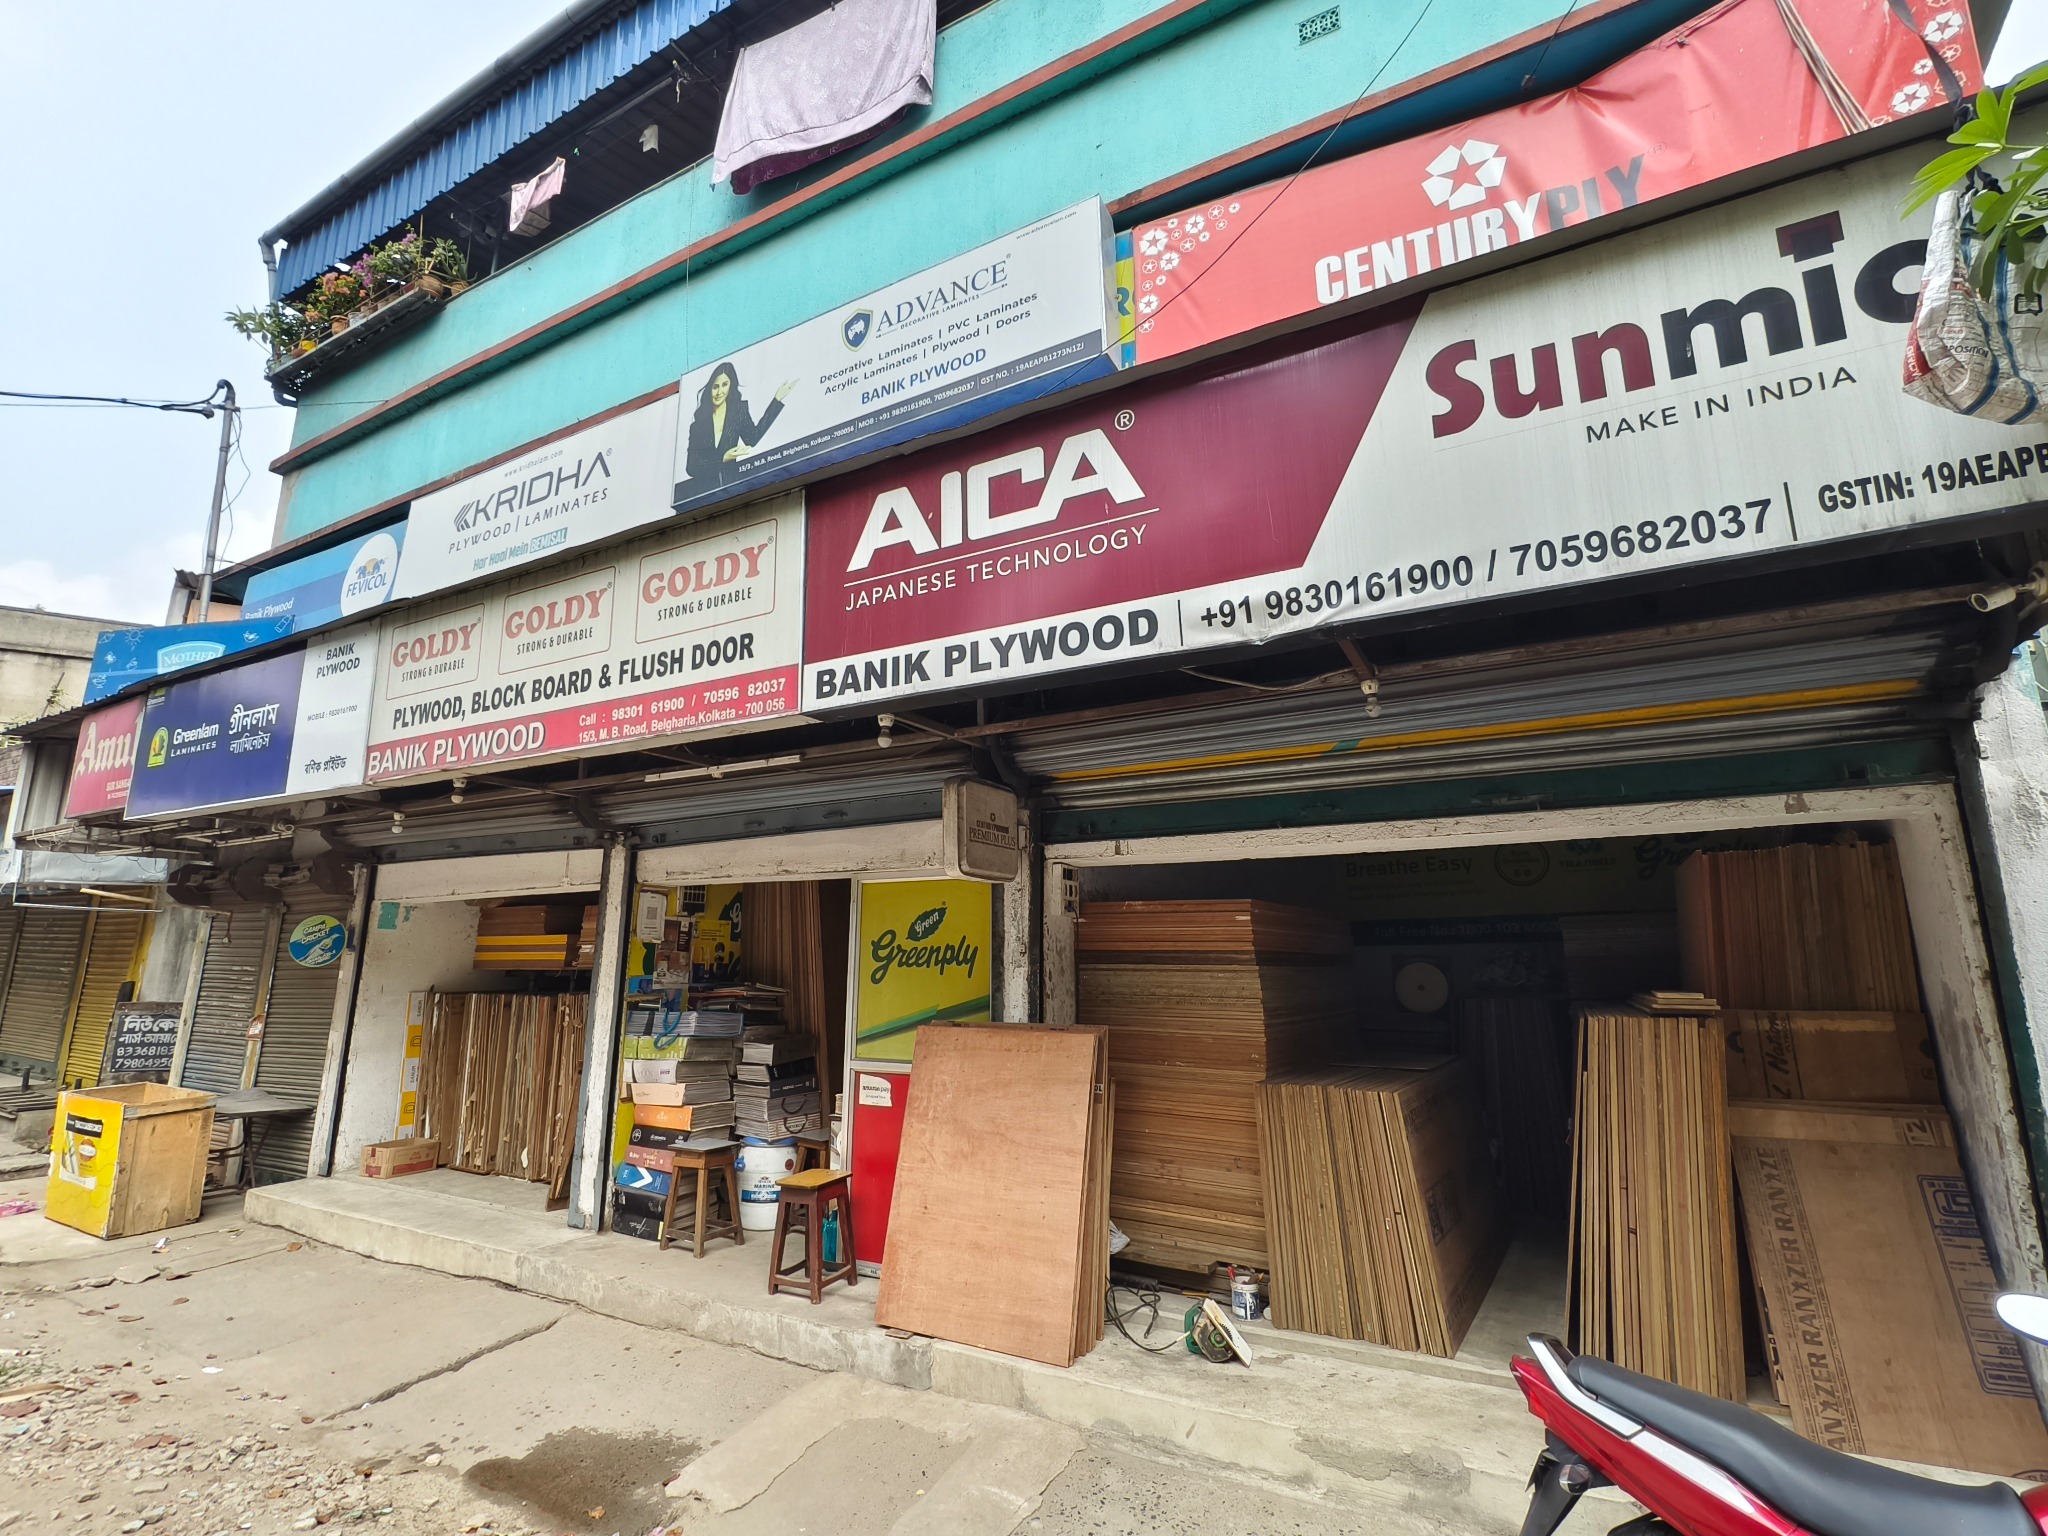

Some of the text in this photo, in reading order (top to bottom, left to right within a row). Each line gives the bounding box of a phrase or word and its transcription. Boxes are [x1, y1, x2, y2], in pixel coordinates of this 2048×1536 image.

[876, 260, 1008, 333] ADVANCE
[900, 293, 980, 330] DECORATIVE LAMINATES
[819, 292, 1038, 385] Decorative Laminates PVC Laminates
[1425, 210, 2046, 440] Sunmic
[824, 309, 1031, 396] Acrylic Laminates Plywood Doors
[858, 418, 874, 429] MOB
[980, 375, 994, 386] GST
[995, 370, 1010, 380] NO.
[861, 348, 987, 405] BANIK PLYWOOD
[1586, 366, 1857, 443] MAKE IN INDIA
[472, 451, 611, 527] KRIDHA
[846, 428, 1146, 573] AICA
[448, 487, 608, 554] PLYWOOD LAMINATES
[473, 555, 488, 572] Har
[508, 541, 529, 560] Mein
[530, 528, 567, 552] BEMISAL
[845, 523, 1148, 612] JAPANESE TECHNOLOGY
[346, 572, 387, 598] FEVICOL
[642, 543, 768, 604] GOLDY
[815, 649, 931, 700] BANIK
[943, 608, 1159, 679] PLYWOOD
[1201, 595, 1253, 629] +91
[1264, 555, 1474, 622] 9830161900
[1508, 498, 1773, 578] 7059682037
[1817, 470, 1915, 514] GSTIN:
[263, 596, 295, 617] Plywood
[505, 586, 608, 639] GOLDY
[657, 586, 752, 622] STRONG & DURABLE
[326, 642, 356, 661] BANIK
[392, 622, 478, 668] GOLDY
[517, 627, 593, 656] STRONG & DURABLE
[316, 657, 360, 679] PLYWOOD
[392, 632, 754, 730] PLYWOOD, BLOCK BOARD & FLUSH DOOR
[401, 658, 465, 683] STRONG & DURABLE
[229, 703, 280, 735] গ্রীনলাম
[307, 711, 325, 722] MOBILE
[578, 731, 598, 744] 15/3,
[599, 728, 609, 741] M.
[611, 726, 621, 738] B.
[623, 722, 649, 737] Road,
[744, 701, 764, 717] 700
[766, 697, 786, 713] 056
[579, 712, 597, 727] Call
[611, 703, 644, 721] 98301
[651, 696, 685, 714] 61900
[703, 686, 740, 705] 70596
[747, 678, 786, 697] 82037
[170, 740, 217, 758] LAMINATES
[172, 722, 220, 745] Greenlam
[368, 721, 545, 777] BANIK PLYWOOD
[968, 826, 1016, 847] PREMIUM PLUS
[1346, 856, 1473, 878] Breathe Easy
[914, 911, 940, 937] Green
[1374, 926, 1396, 938] Toll
[1399, 926, 1427, 938] Free
[871, 929, 979, 985] Greenply
[116, 1046, 175, 1057] 83368183
